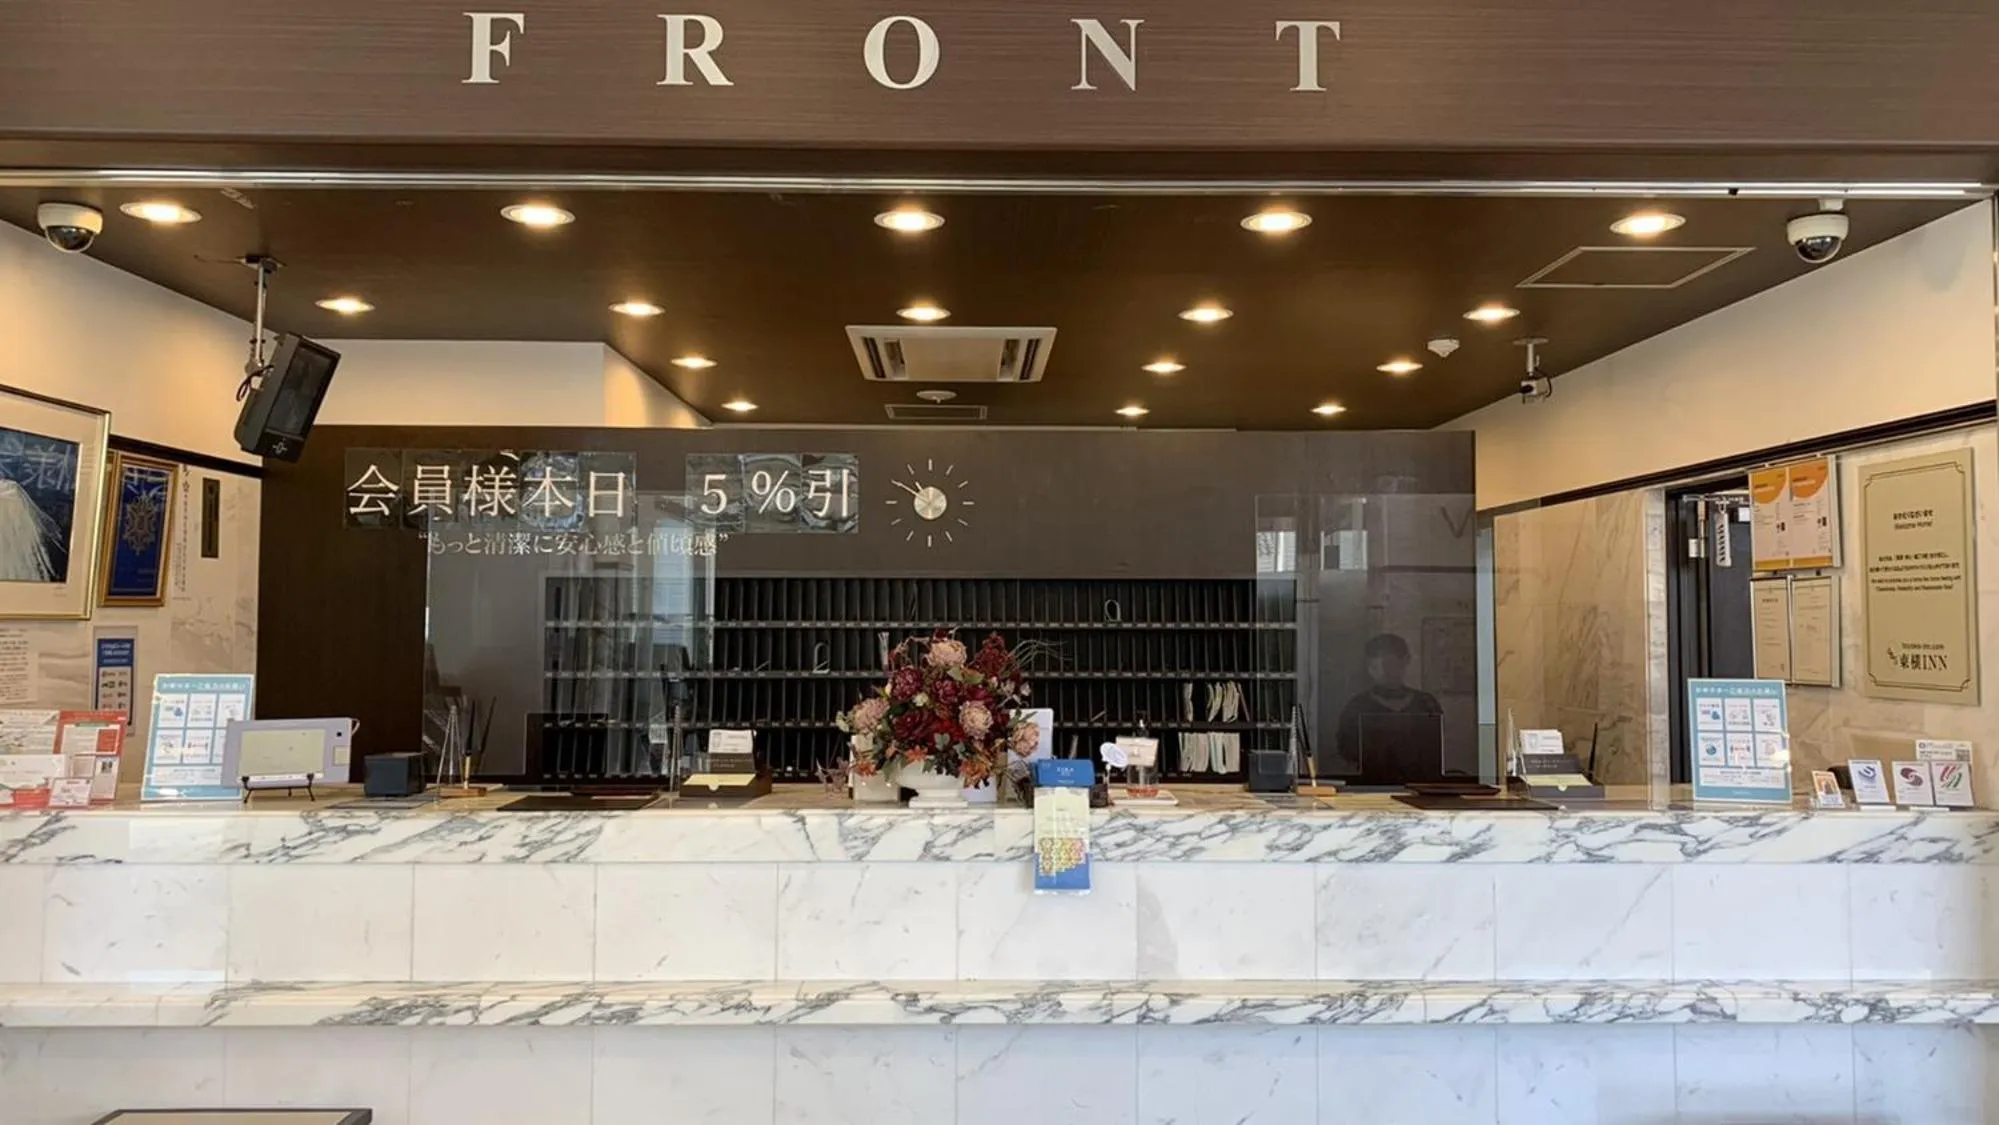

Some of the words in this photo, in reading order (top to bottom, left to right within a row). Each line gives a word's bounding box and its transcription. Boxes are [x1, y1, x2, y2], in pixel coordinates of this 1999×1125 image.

[461, 11, 1342, 93] FRONT
[346, 464, 628, 520] 会員様本日
